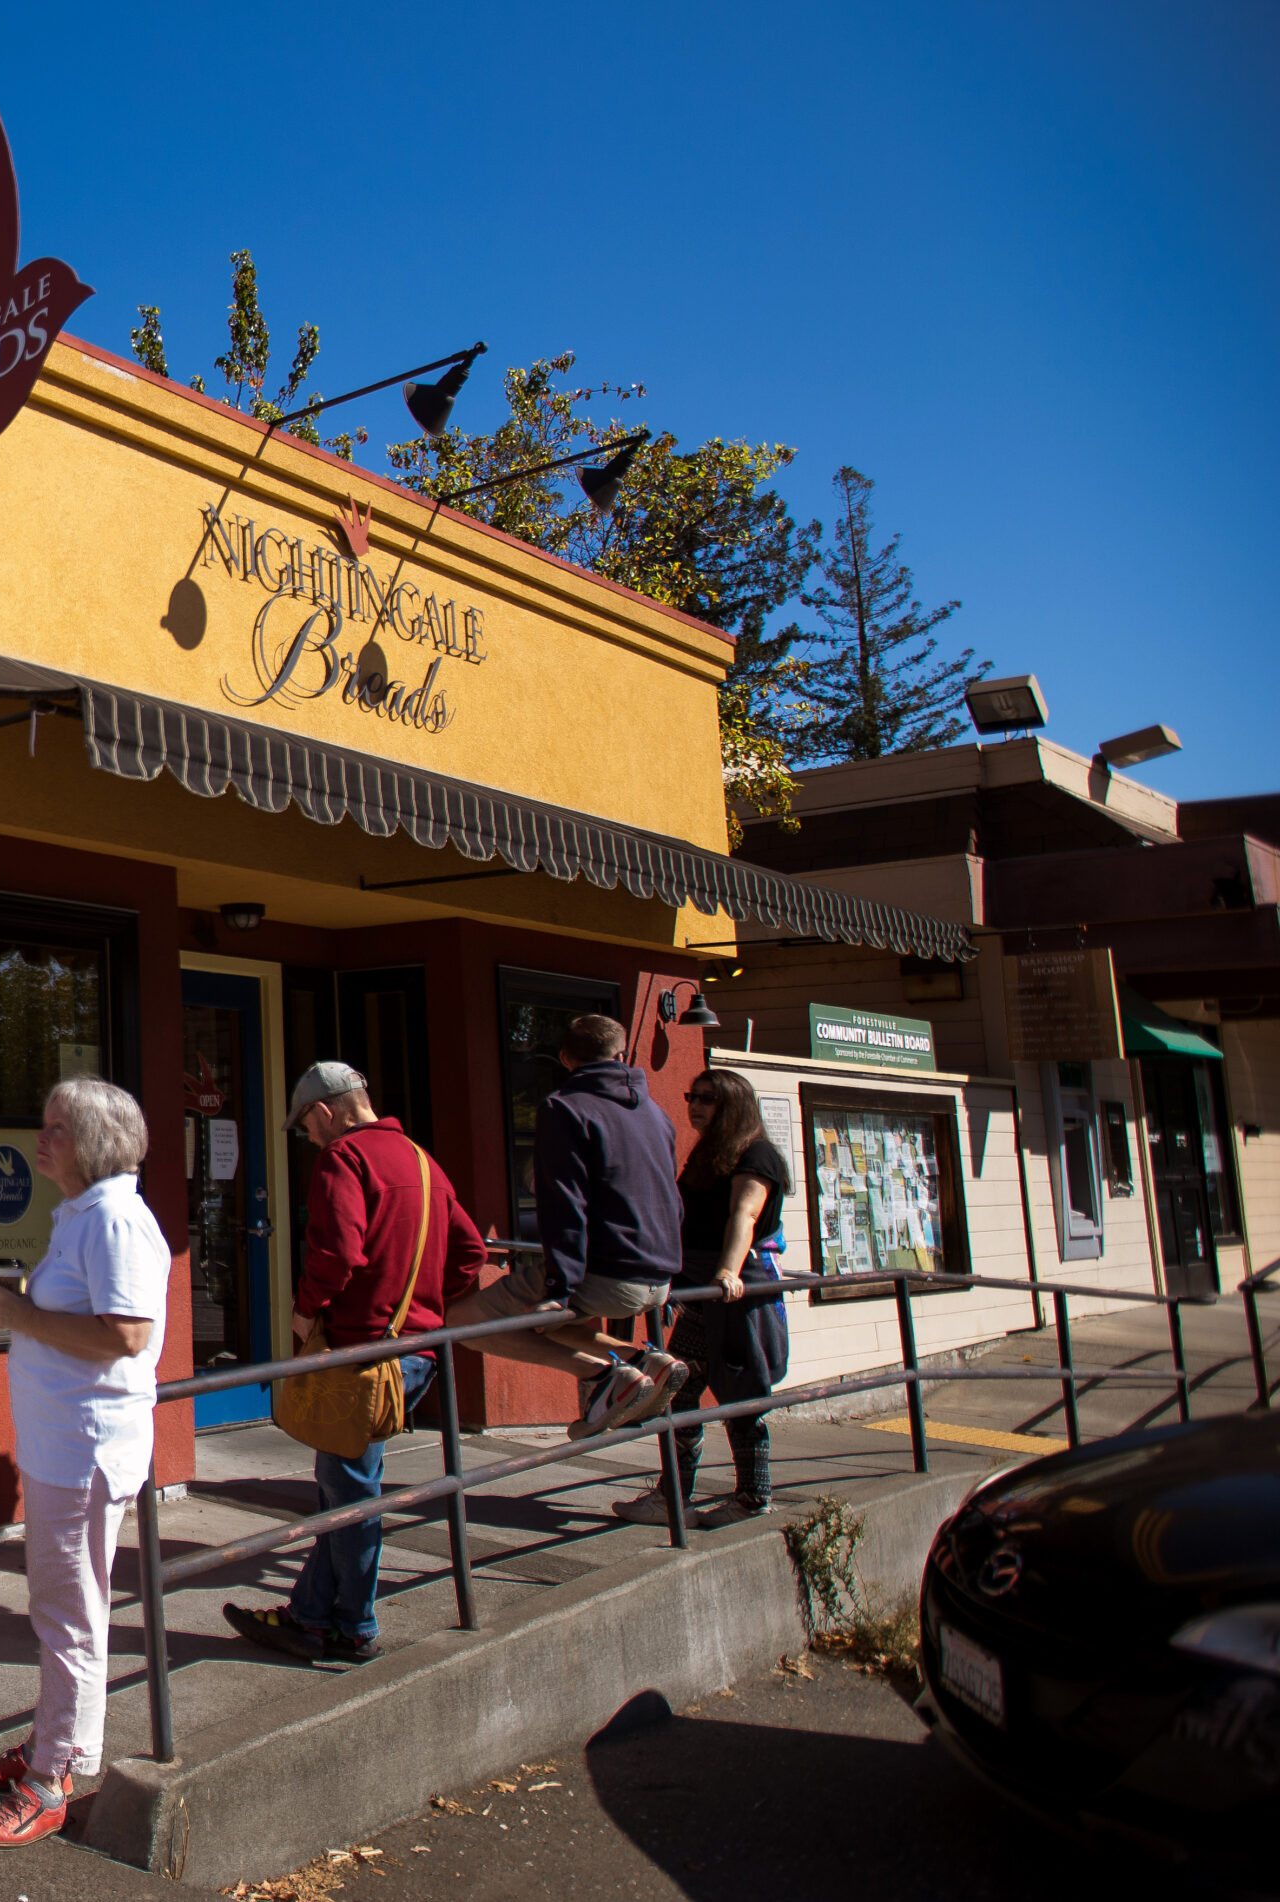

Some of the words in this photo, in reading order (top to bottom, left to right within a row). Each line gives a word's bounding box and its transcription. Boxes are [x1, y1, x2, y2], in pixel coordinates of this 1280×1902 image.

[202, 502, 488, 662] NIGHTINGALE
[222, 586, 457, 732] Breads
[816, 1022, 867, 1044] COMMUNITY
[867, 1030, 904, 1049] BULLETIN
[904, 1034, 931, 1052] BOARD
[852, 1015, 897, 1030] FORESTVILLE
[199, 1093, 221, 1107] OPEN
